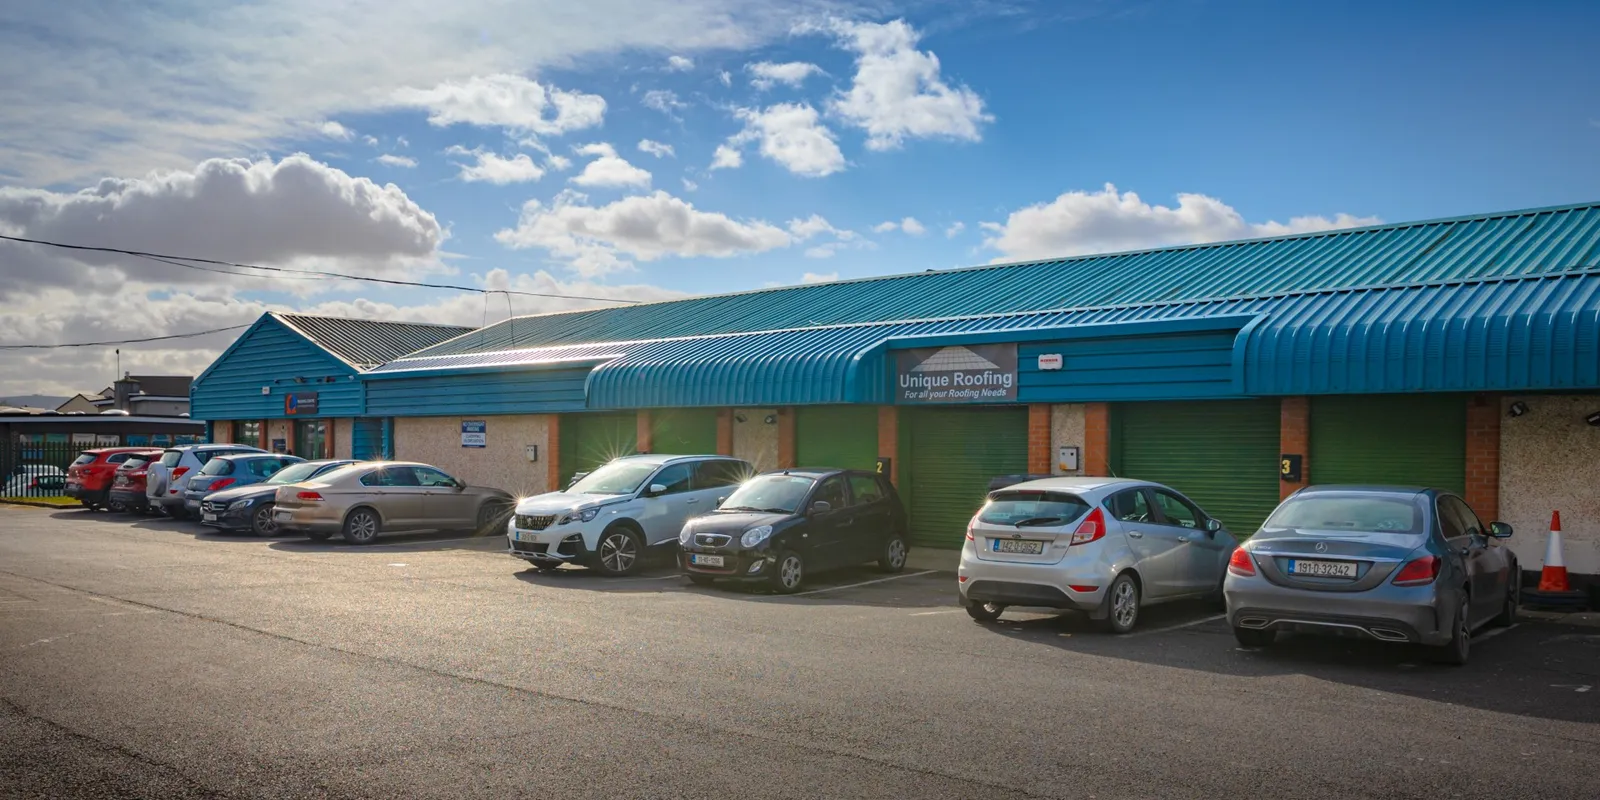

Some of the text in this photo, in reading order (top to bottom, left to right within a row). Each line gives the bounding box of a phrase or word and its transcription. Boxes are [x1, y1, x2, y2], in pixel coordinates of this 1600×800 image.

[900, 371, 1013, 389] Unique Roofing
[905, 388, 1007, 400] For all your Roofing Needs
[876, 461, 883, 474] 2
[1281, 459, 1291, 474] 3
